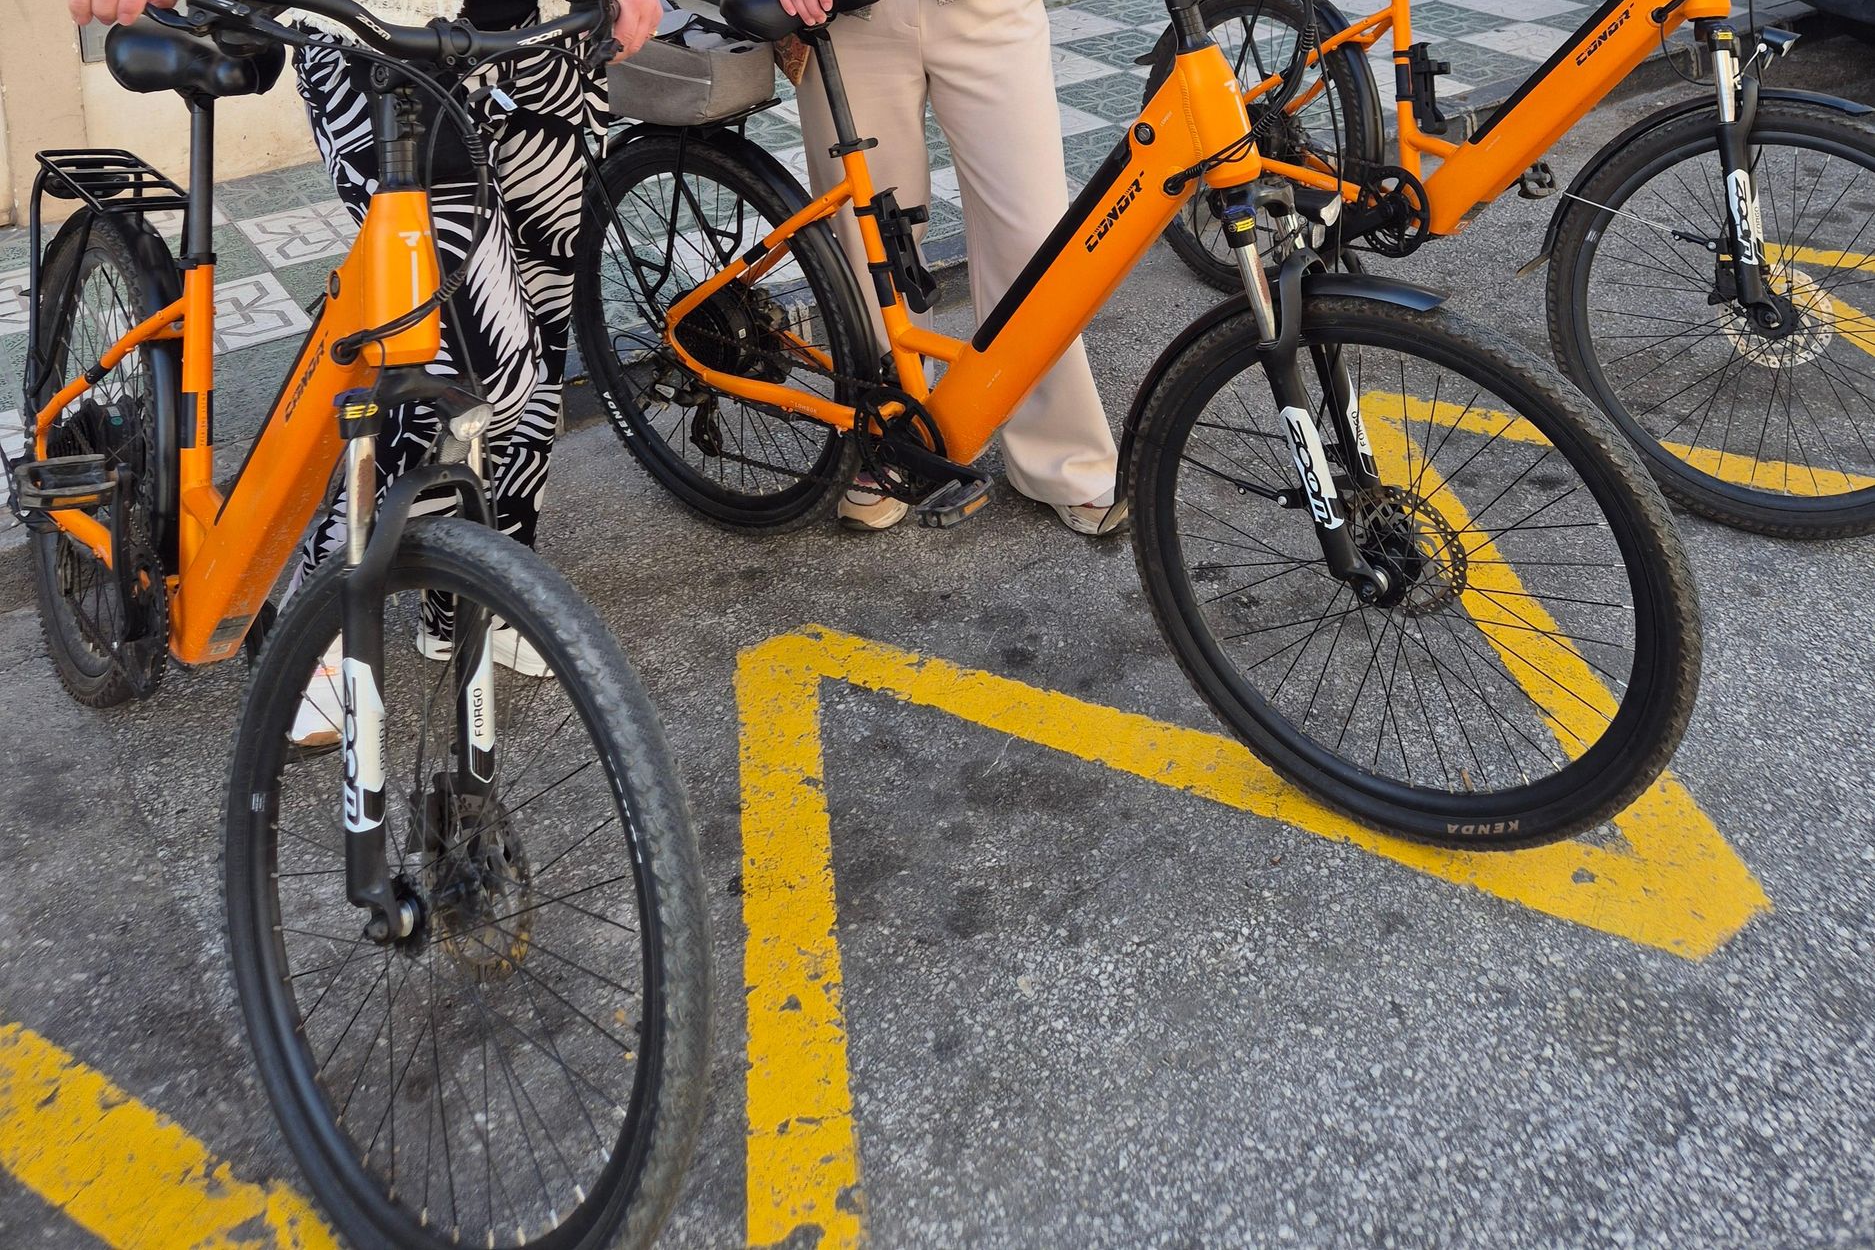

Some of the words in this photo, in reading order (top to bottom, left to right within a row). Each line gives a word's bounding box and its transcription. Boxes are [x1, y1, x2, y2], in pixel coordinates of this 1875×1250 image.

[1085, 178, 1142, 253] CONOR
[603, 391, 634, 437] KENDA
[473, 688, 484, 737] FORGO
[1447, 819, 1520, 835] KENDA
